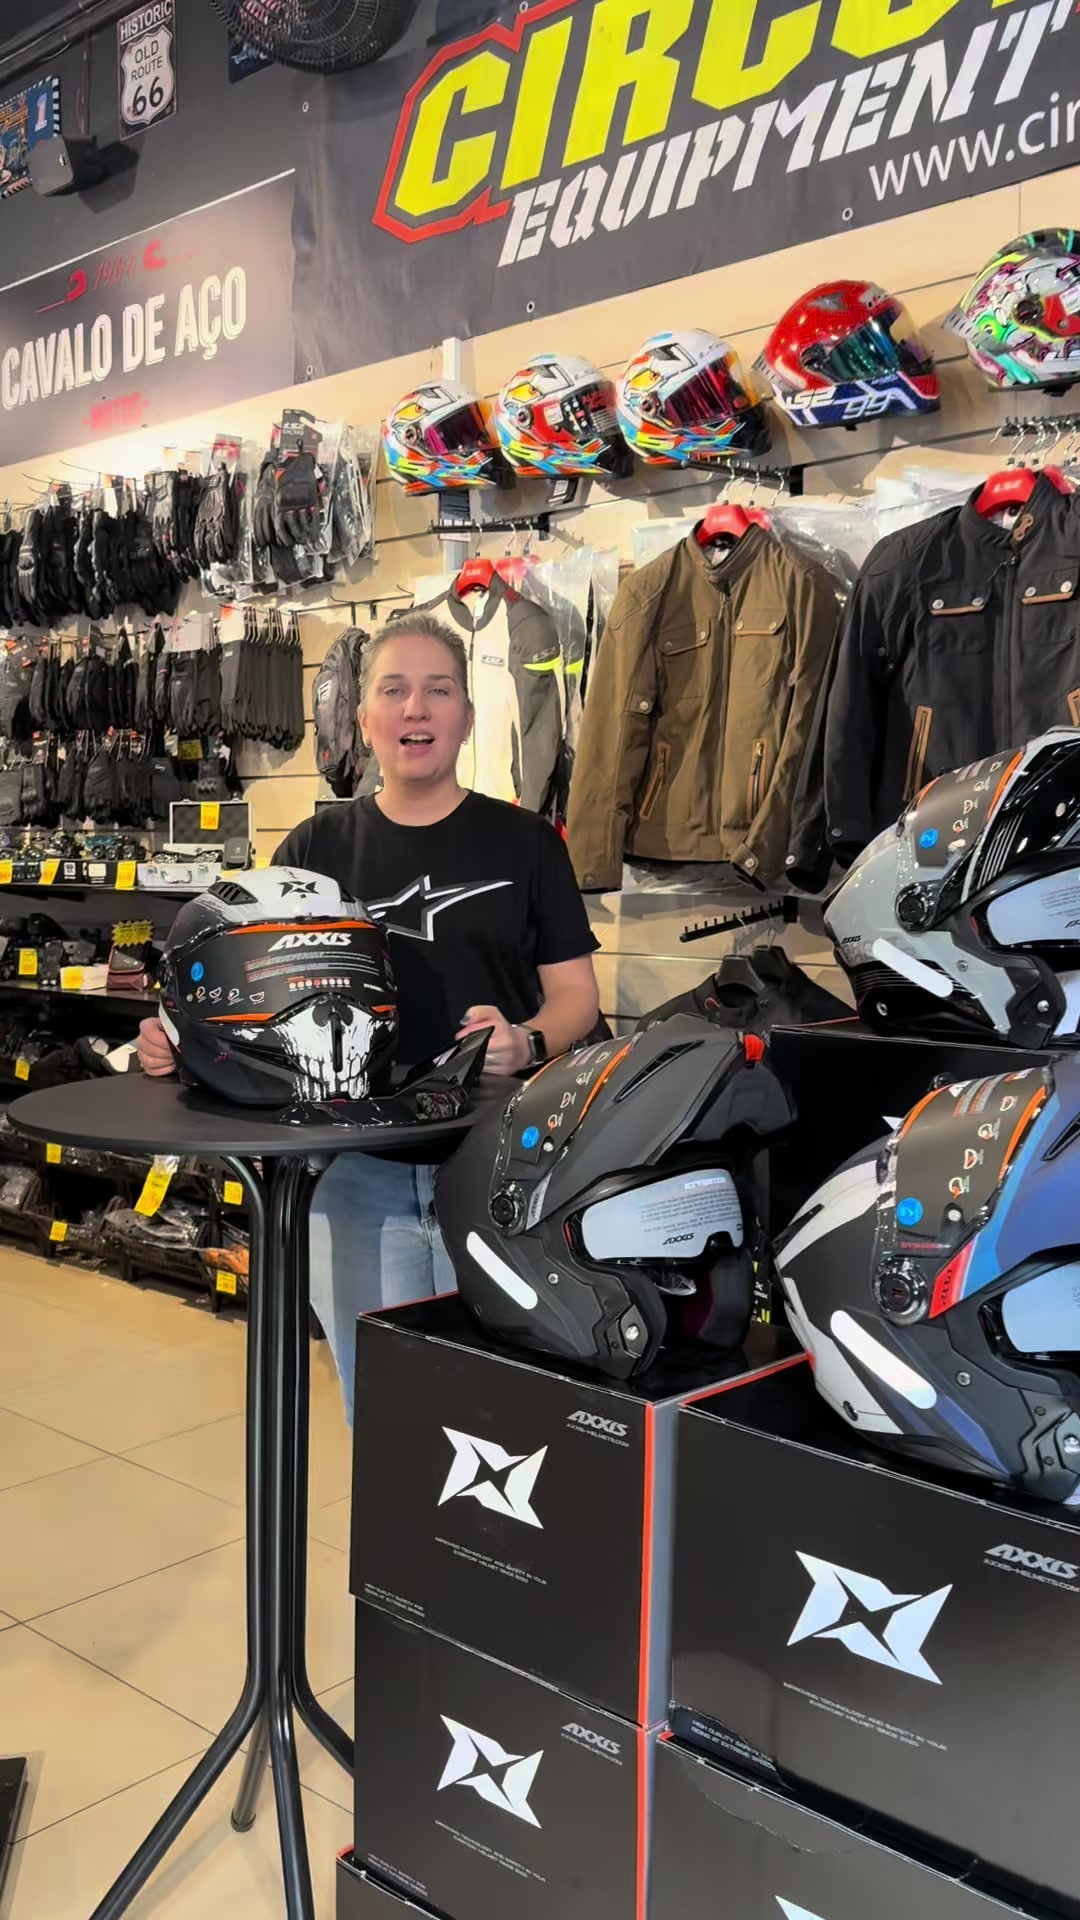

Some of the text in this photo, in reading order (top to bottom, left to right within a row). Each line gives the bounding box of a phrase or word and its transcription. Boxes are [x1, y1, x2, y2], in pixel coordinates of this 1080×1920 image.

[121, 0, 173, 41] HISTORIC
[131, 56, 163, 81] ROUTE
[134, 40, 159, 64] OLD
[132, 76, 164, 116] 66
[498, 0, 1074, 267] EQUIPMENT
[1, 266, 247, 410] CAVALO DE AÇO
[267, 932, 352, 952] AXXIS
[567, 1410, 629, 1437] AXXIS
[984, 1543, 1080, 1579] AXXIS
[561, 1722, 621, 1754] AXXIS
